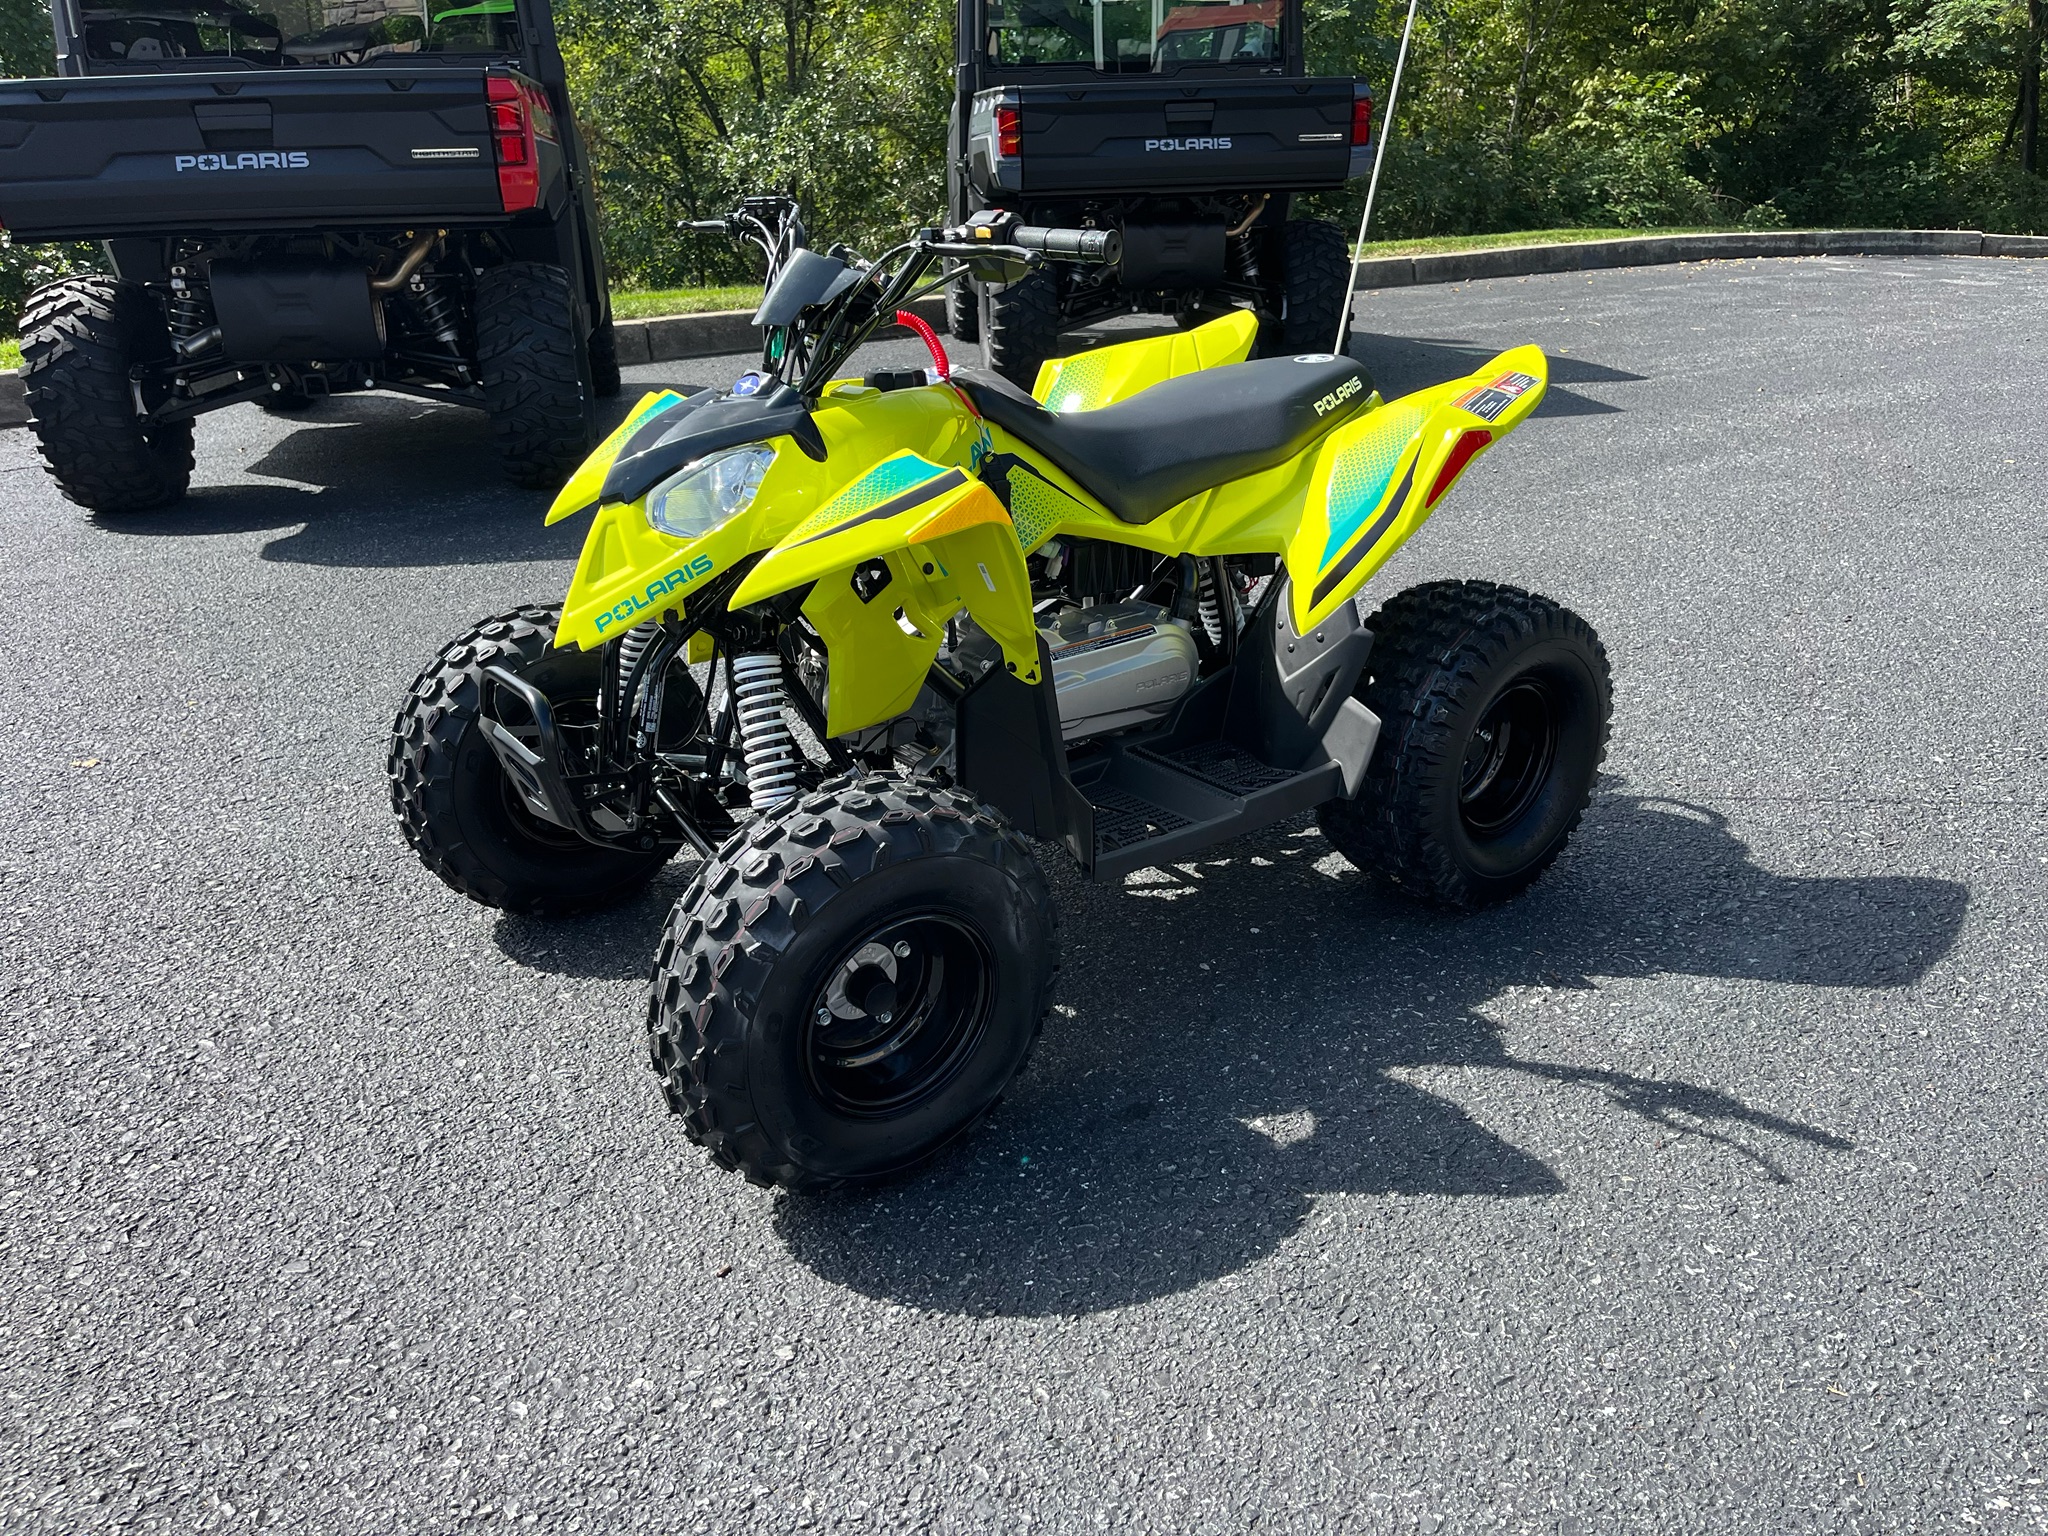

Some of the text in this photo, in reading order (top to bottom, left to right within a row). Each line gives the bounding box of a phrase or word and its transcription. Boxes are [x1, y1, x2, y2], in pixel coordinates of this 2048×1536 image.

[1145, 137, 1233, 152] POLARIS
[175, 151, 310, 172] POLARIS
[1313, 375, 1363, 417] POLARIS
[594, 553, 714, 633] POLARIS
[1136, 670, 1188, 692] POLARIS
